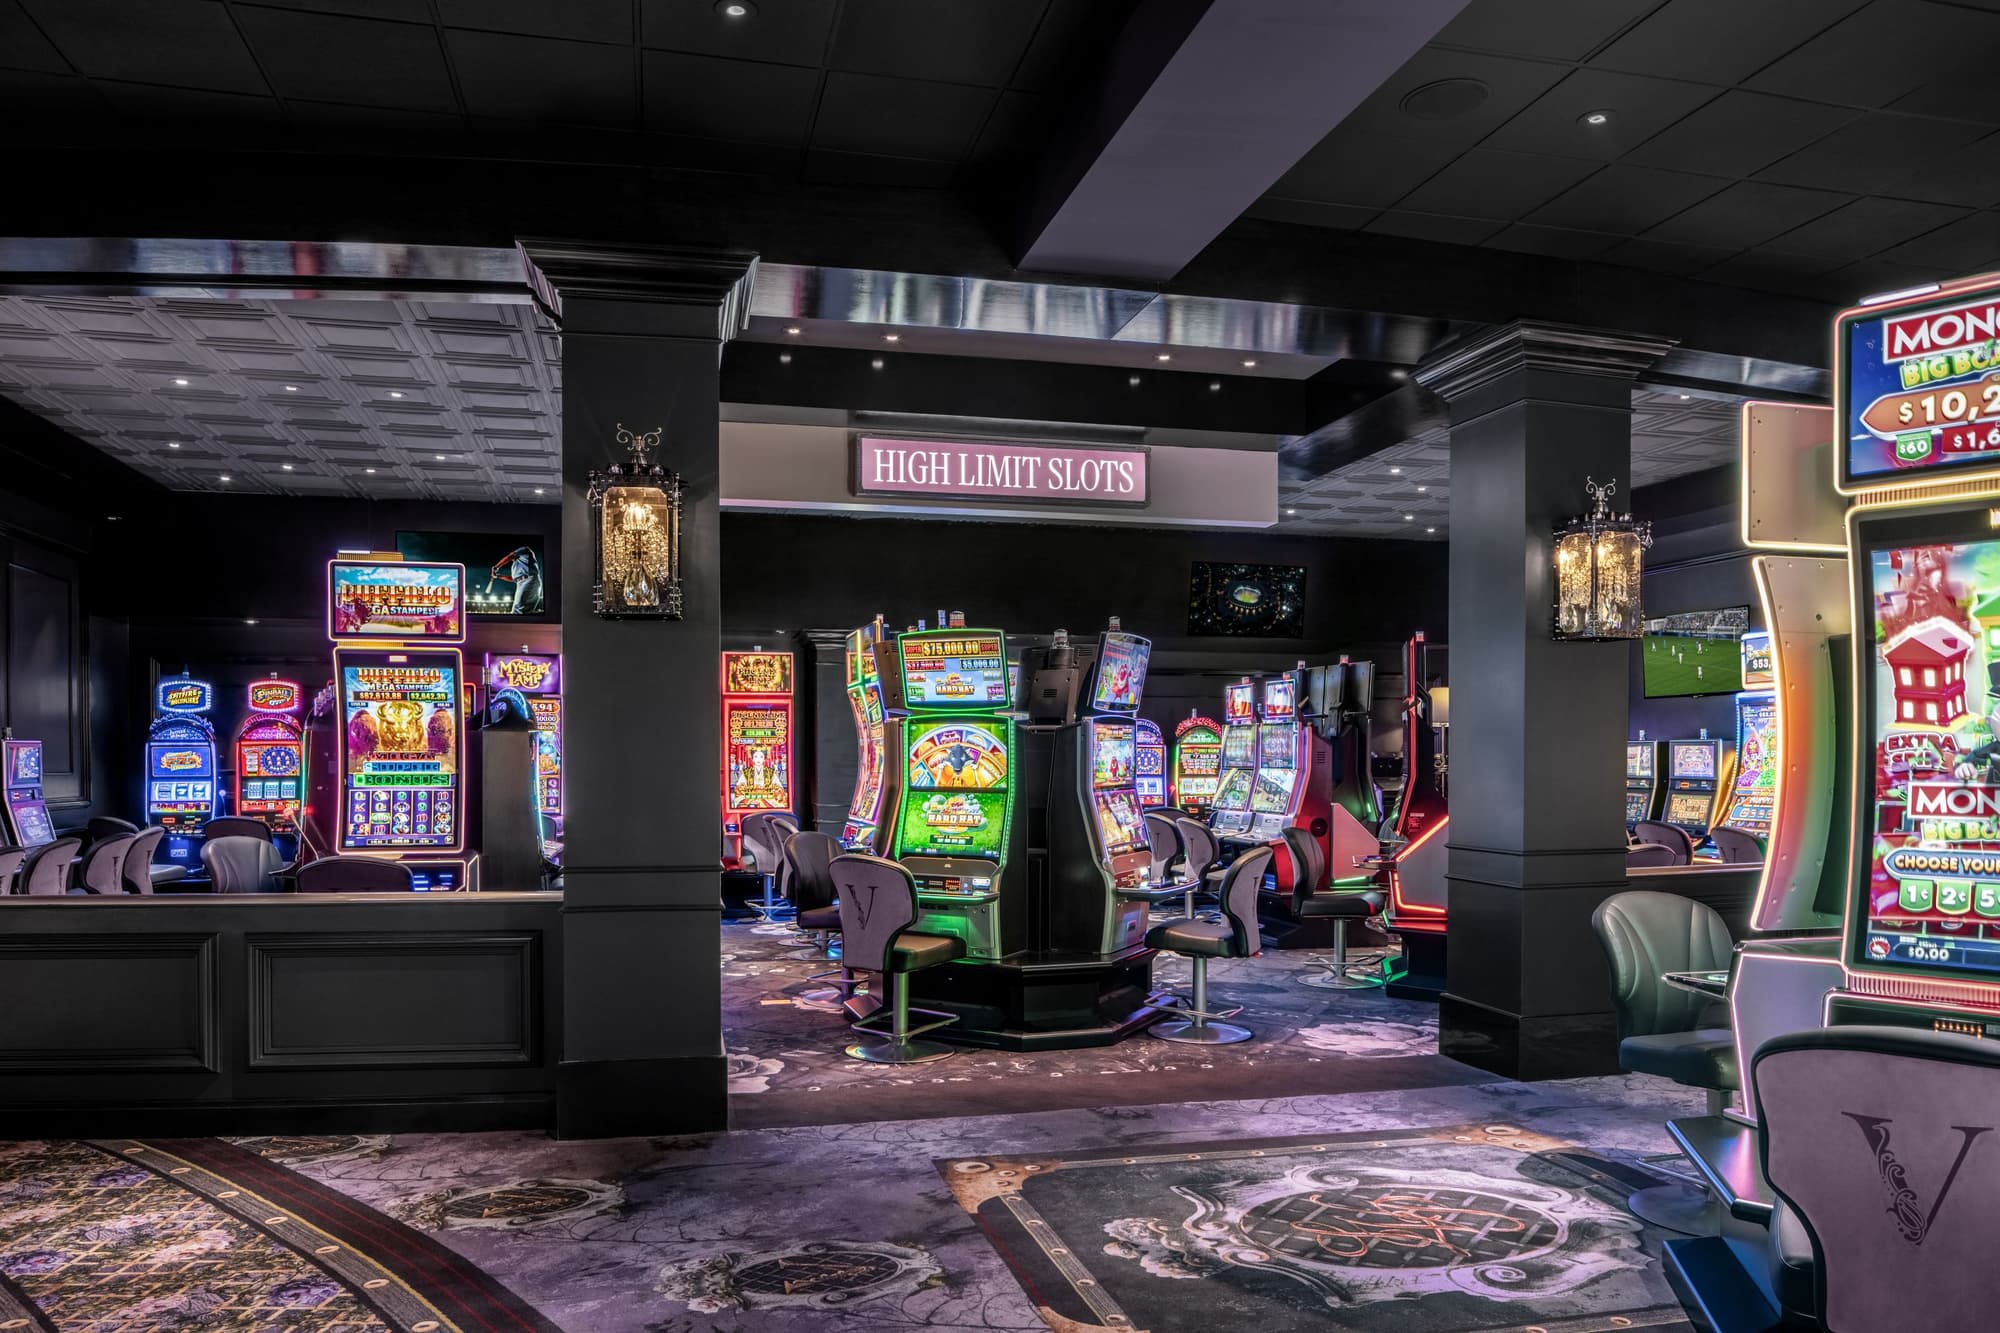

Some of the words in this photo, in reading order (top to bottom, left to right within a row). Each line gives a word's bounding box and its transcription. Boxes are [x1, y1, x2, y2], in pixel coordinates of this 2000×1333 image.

[1893, 306, 2000, 354] MON
[1904, 356, 1949, 387] BIG
[1899, 440, 1928, 455] $60
[873, 449, 951, 485] HIGH
[957, 452, 1041, 489] LIMIT
[1048, 457, 1134, 493] SLOTS
[923, 641, 979, 656] $75,000.00
[499, 659, 552, 678] MYSTERY
[508, 673, 543, 689] LAMP
[1923, 822, 1962, 840] BIG
[1894, 854, 1958, 871] CHOOSE
